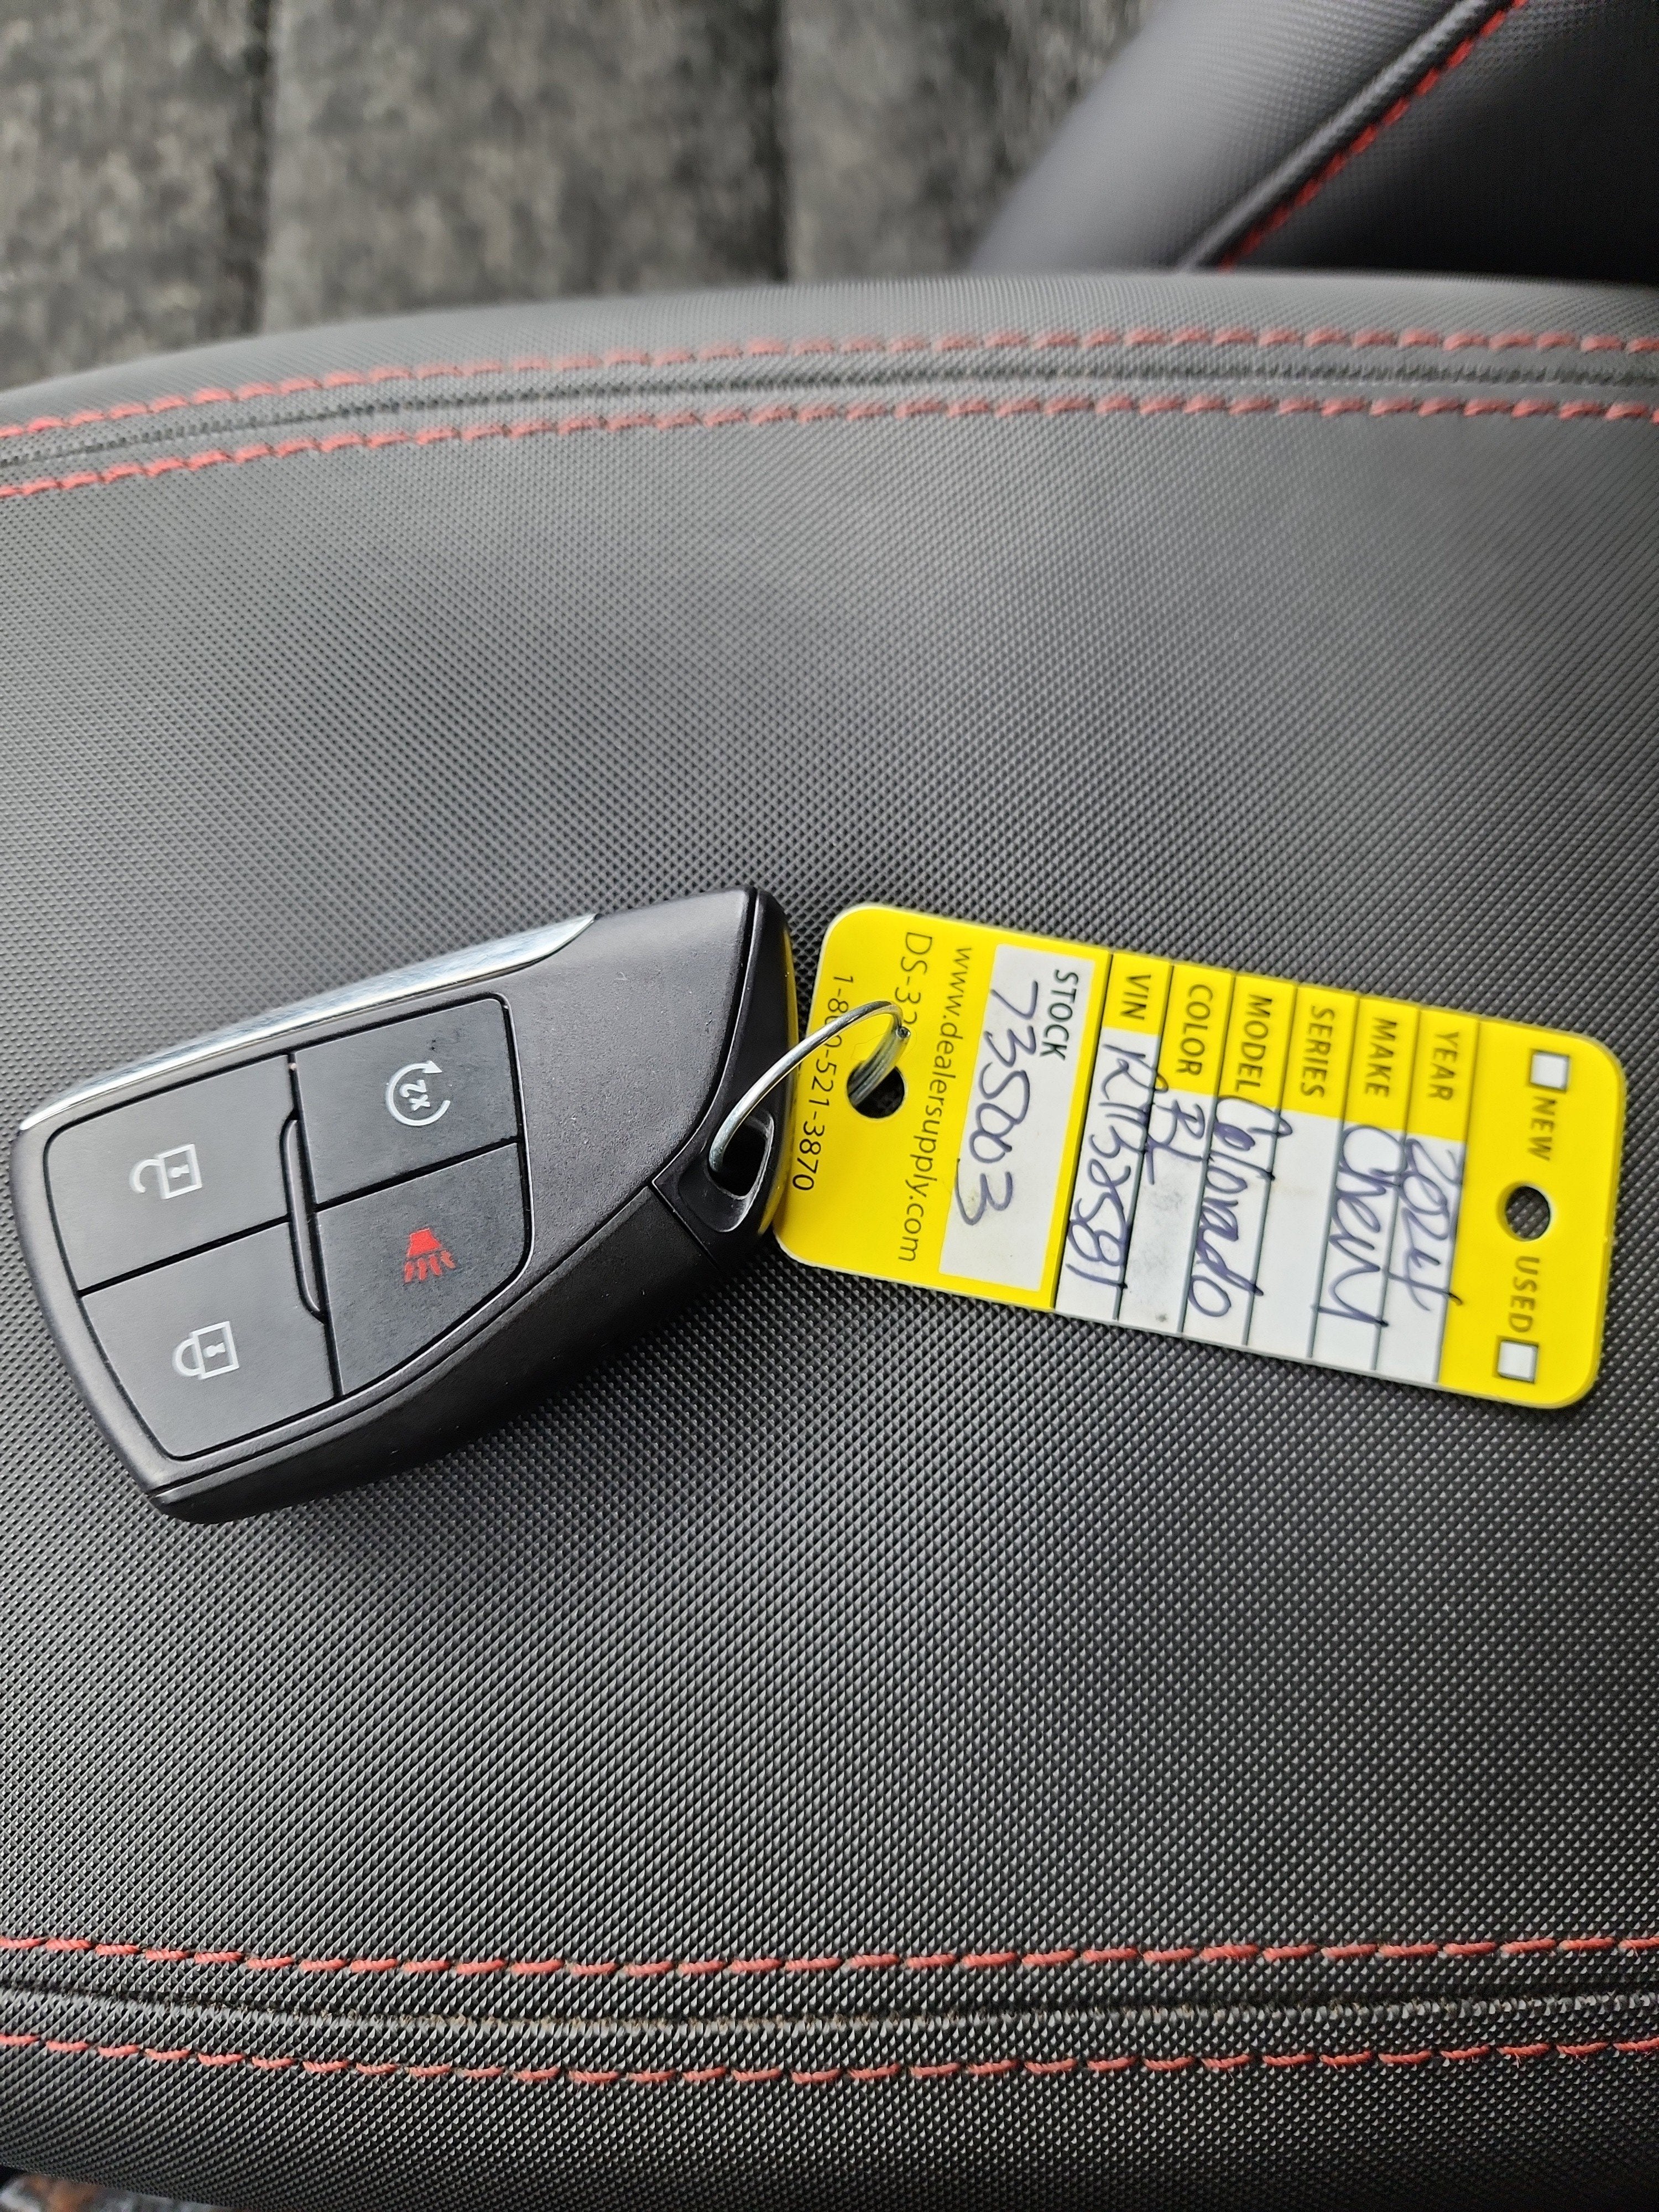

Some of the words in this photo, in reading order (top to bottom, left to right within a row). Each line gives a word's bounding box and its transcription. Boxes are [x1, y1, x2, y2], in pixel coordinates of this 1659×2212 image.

[1040, 969, 1078, 1061] STOCK
[1120, 974, 1151, 1021] VIN
[1176, 984, 1213, 1076] COLOR
[1235, 994, 1272, 1092] MODEL
[1301, 1005, 1334, 1098] SERIES
[1364, 1016, 1397, 1097] MAKE
[1427, 1031, 1459, 1101] YEAR
[899, 947, 973, 1262] www.dealersupply.com
[1527, 1095, 1556, 1161] NEW
[1189, 1097, 1292, 1317] Colorado
[1312, 1125, 1407, 1327] Chevy
[1384, 1139, 1463, 1311] 2024
[1509, 1256, 1541, 1333] USED
